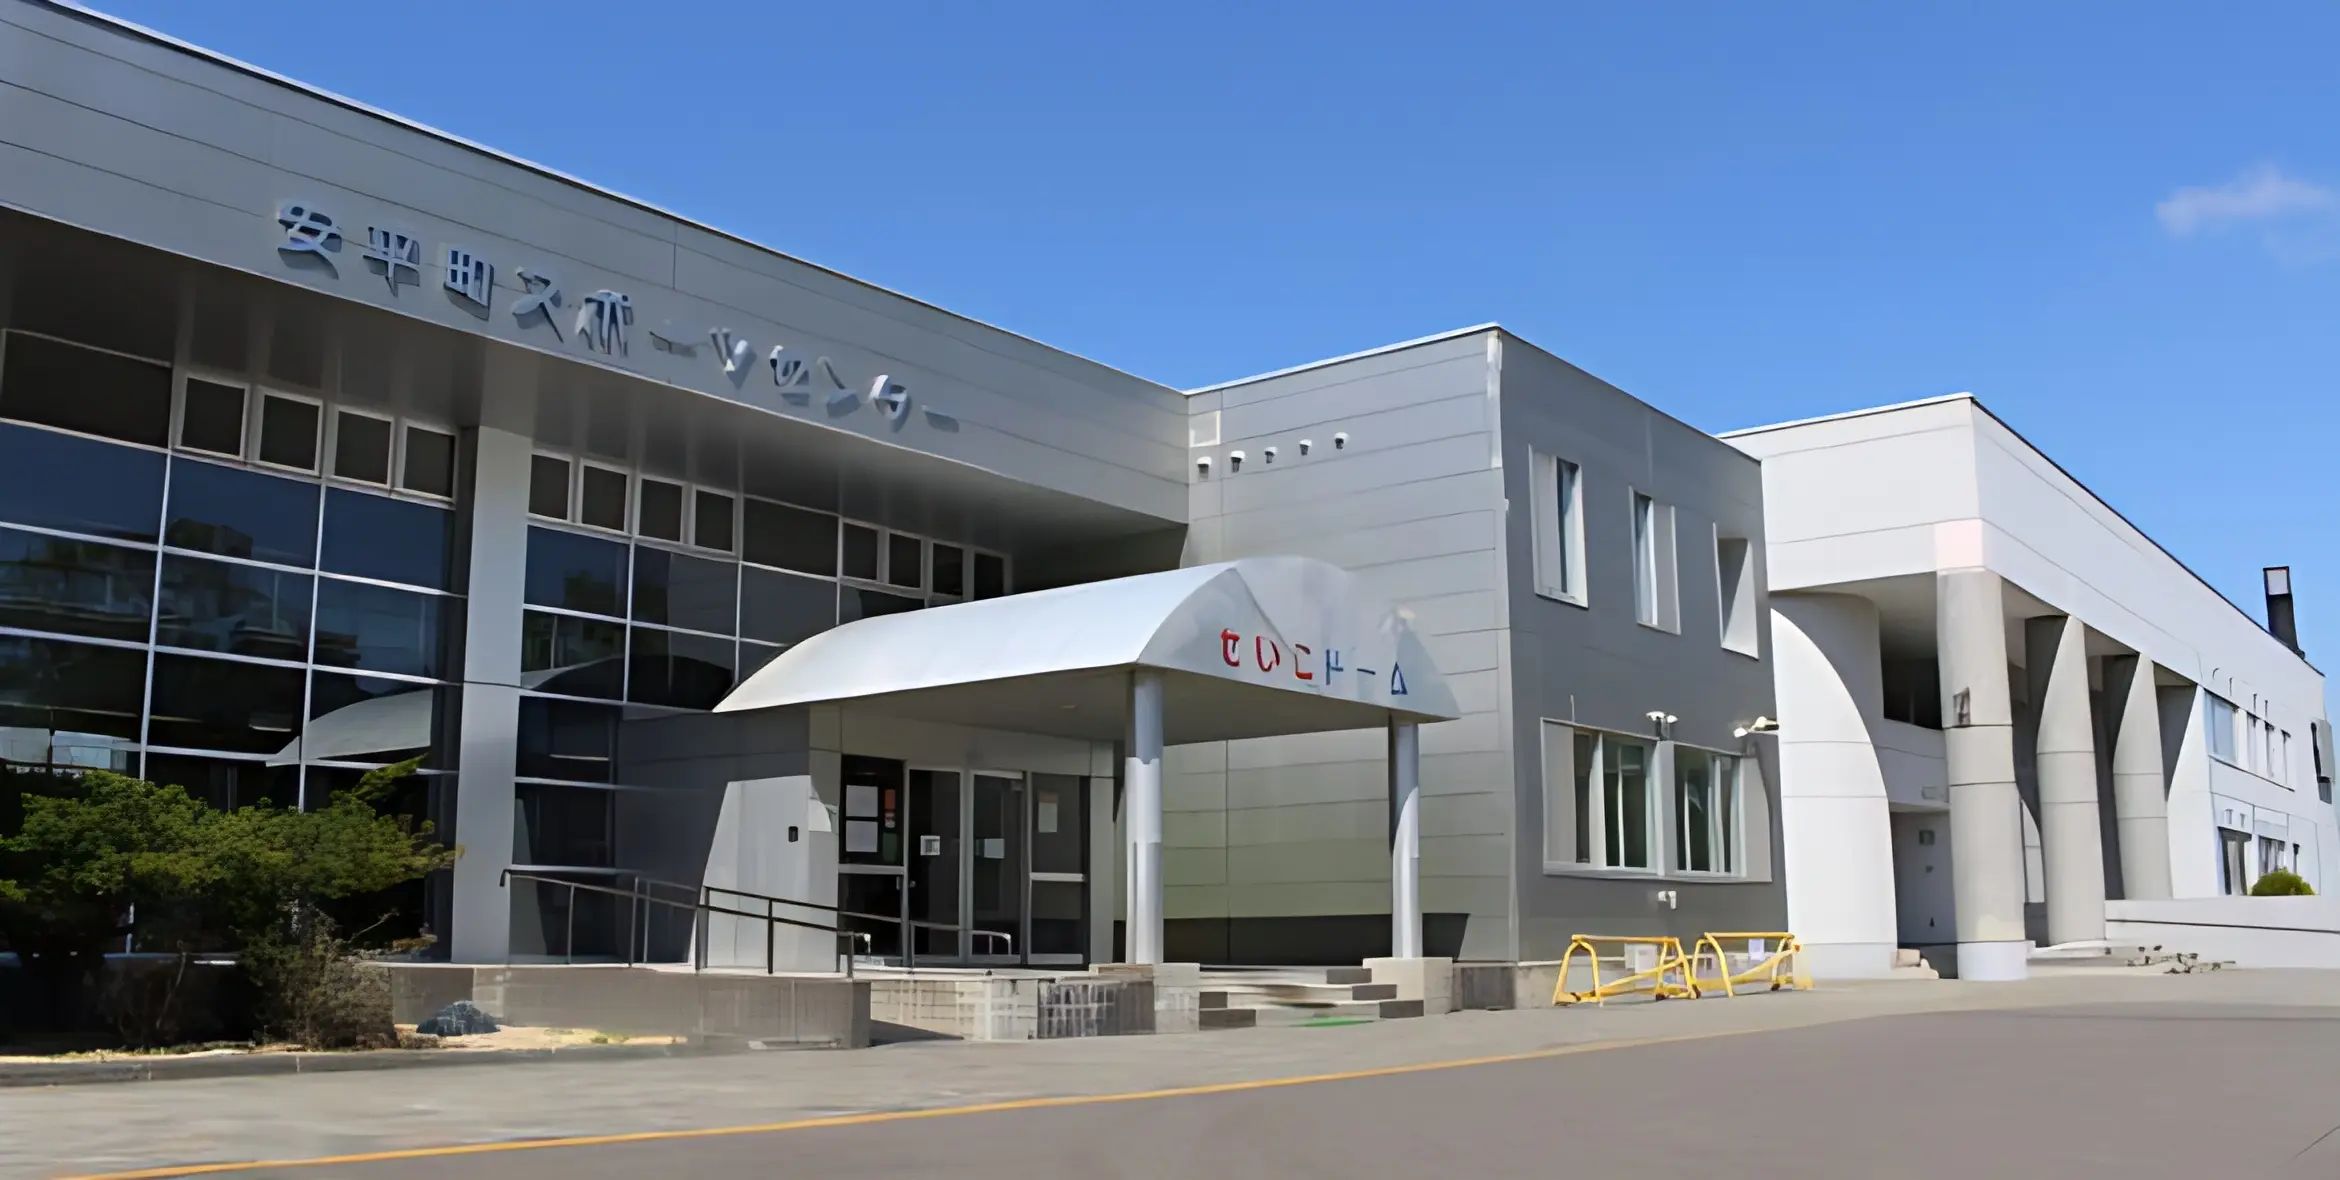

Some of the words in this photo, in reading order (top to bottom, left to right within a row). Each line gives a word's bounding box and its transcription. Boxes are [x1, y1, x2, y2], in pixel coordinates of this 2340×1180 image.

[1221, 628, 1408, 695] せいこドーム
